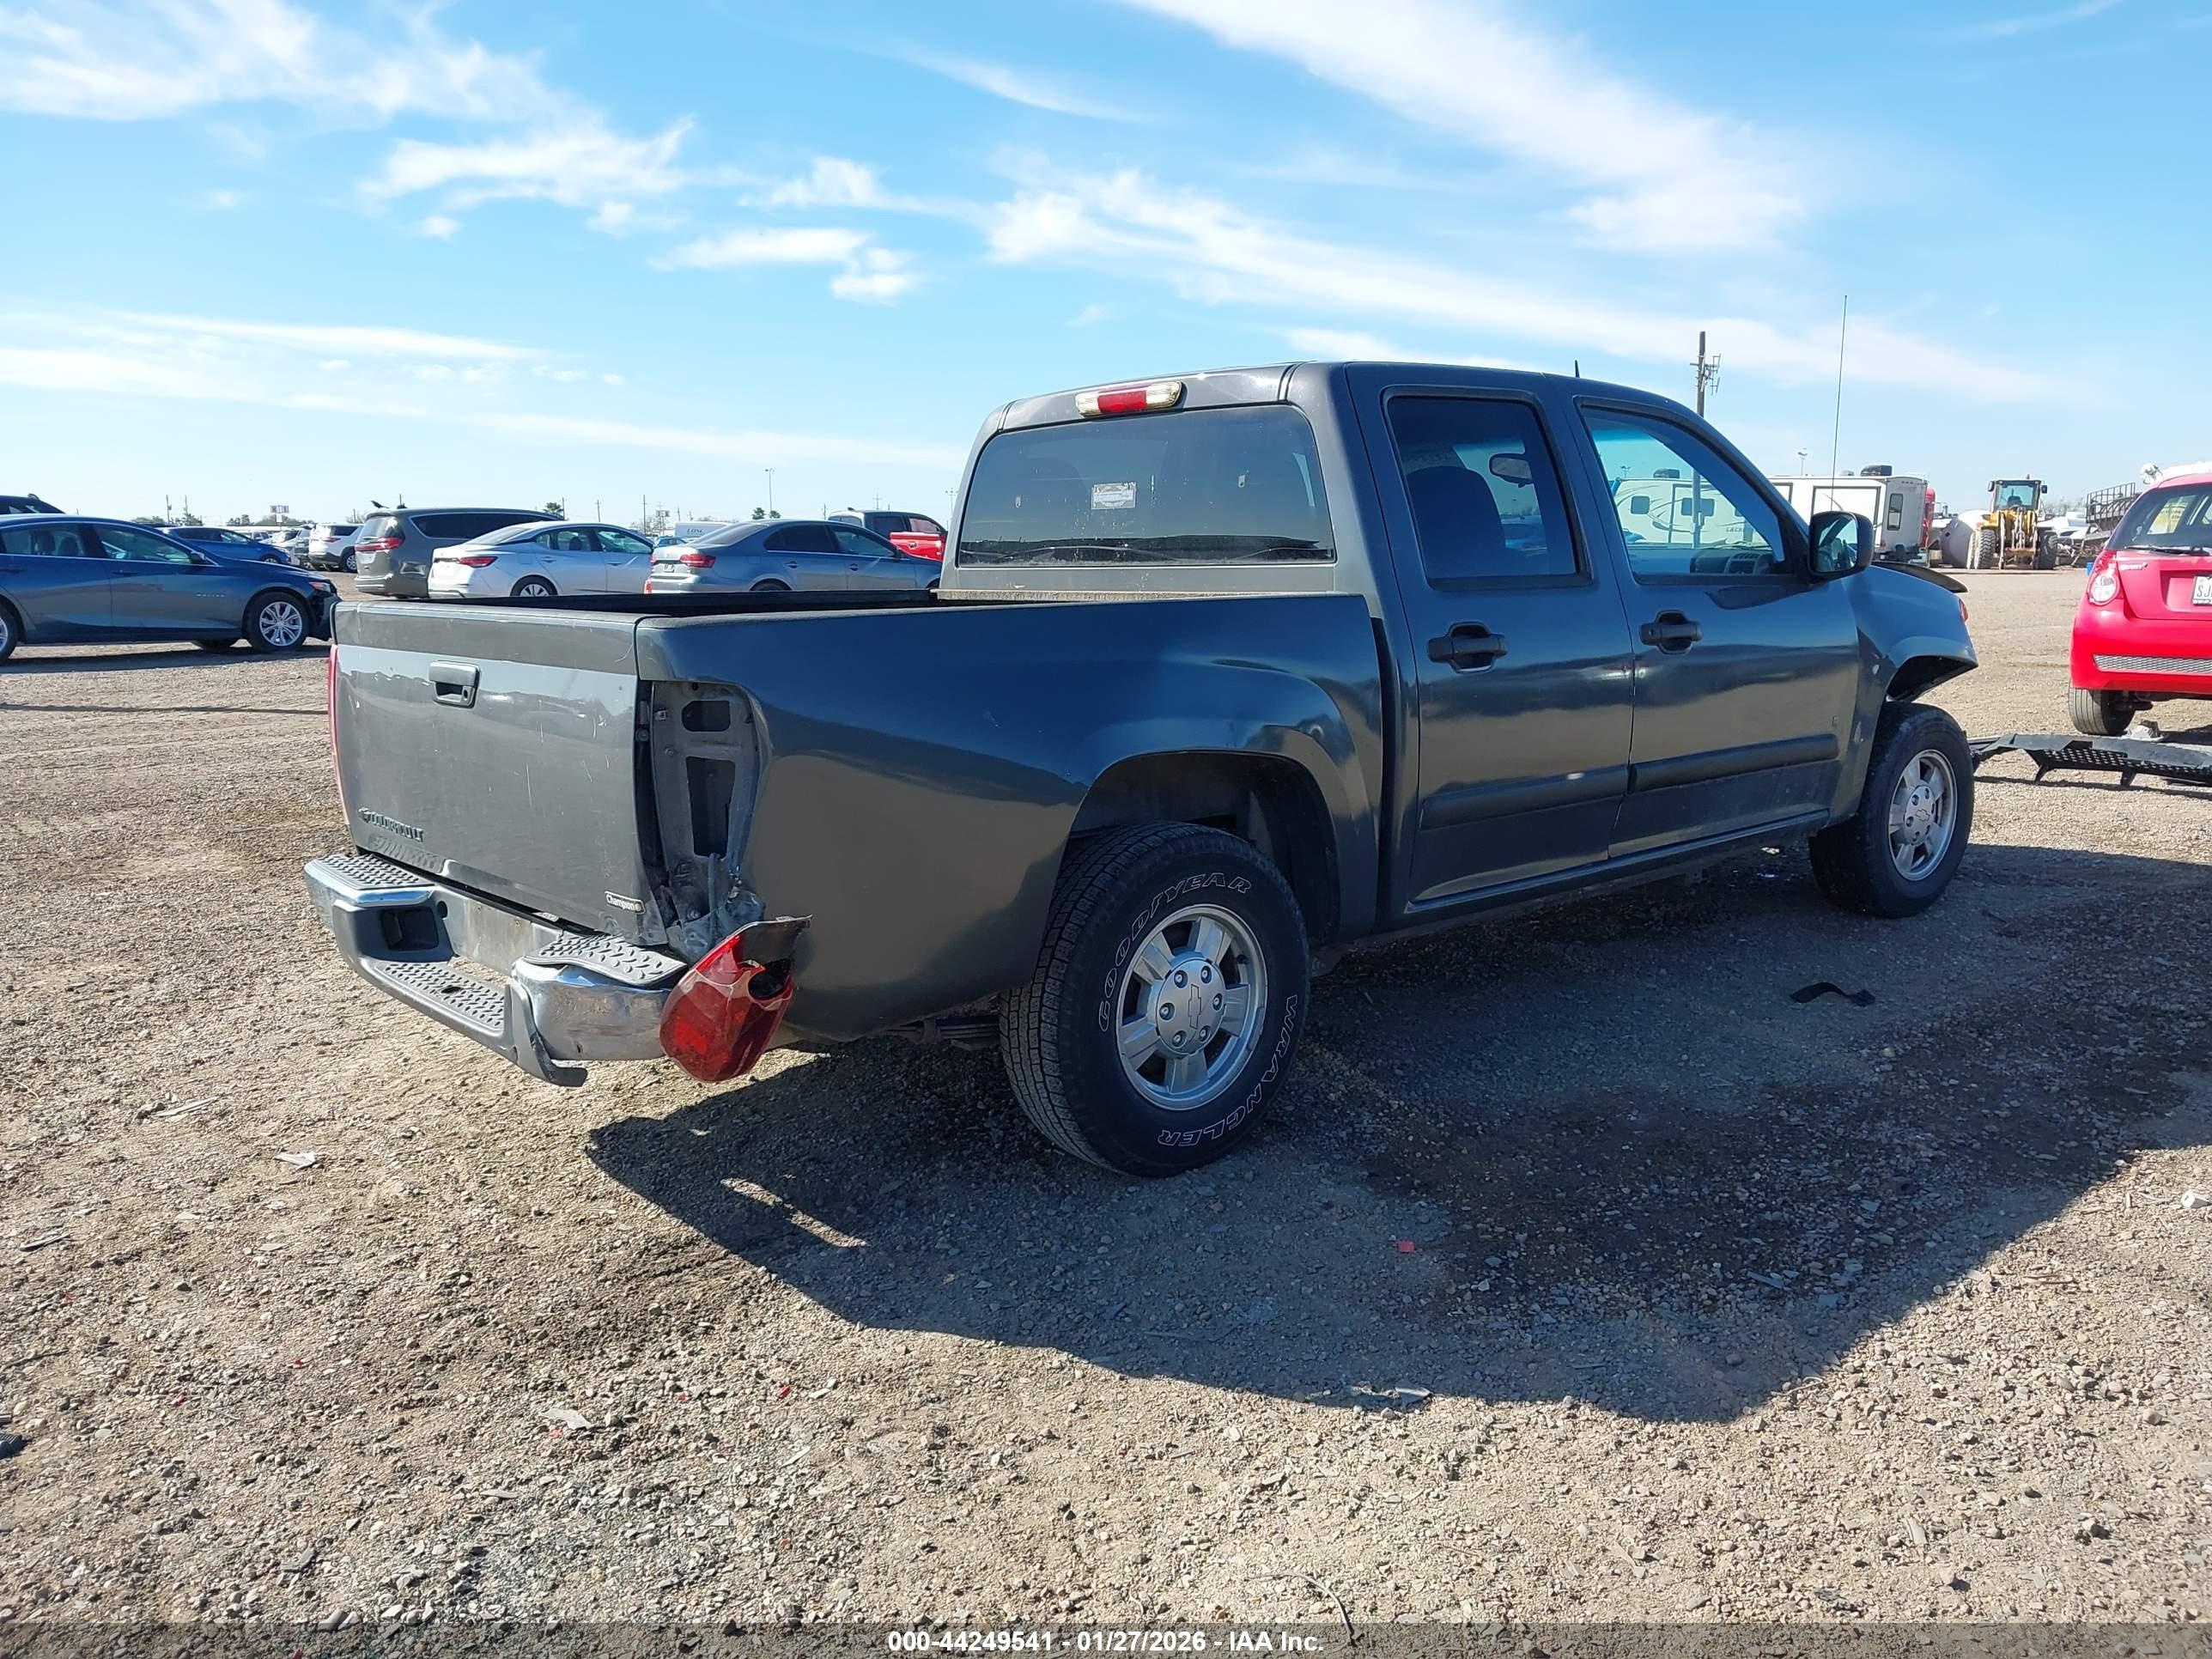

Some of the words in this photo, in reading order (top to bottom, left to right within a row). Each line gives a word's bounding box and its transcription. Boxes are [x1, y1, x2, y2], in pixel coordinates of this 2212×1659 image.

[2196, 584, 2212, 598] SJ
[1099, 872, 1252, 1032] GOODYEAR
[1158, 994, 1298, 1147] WRANGLER
